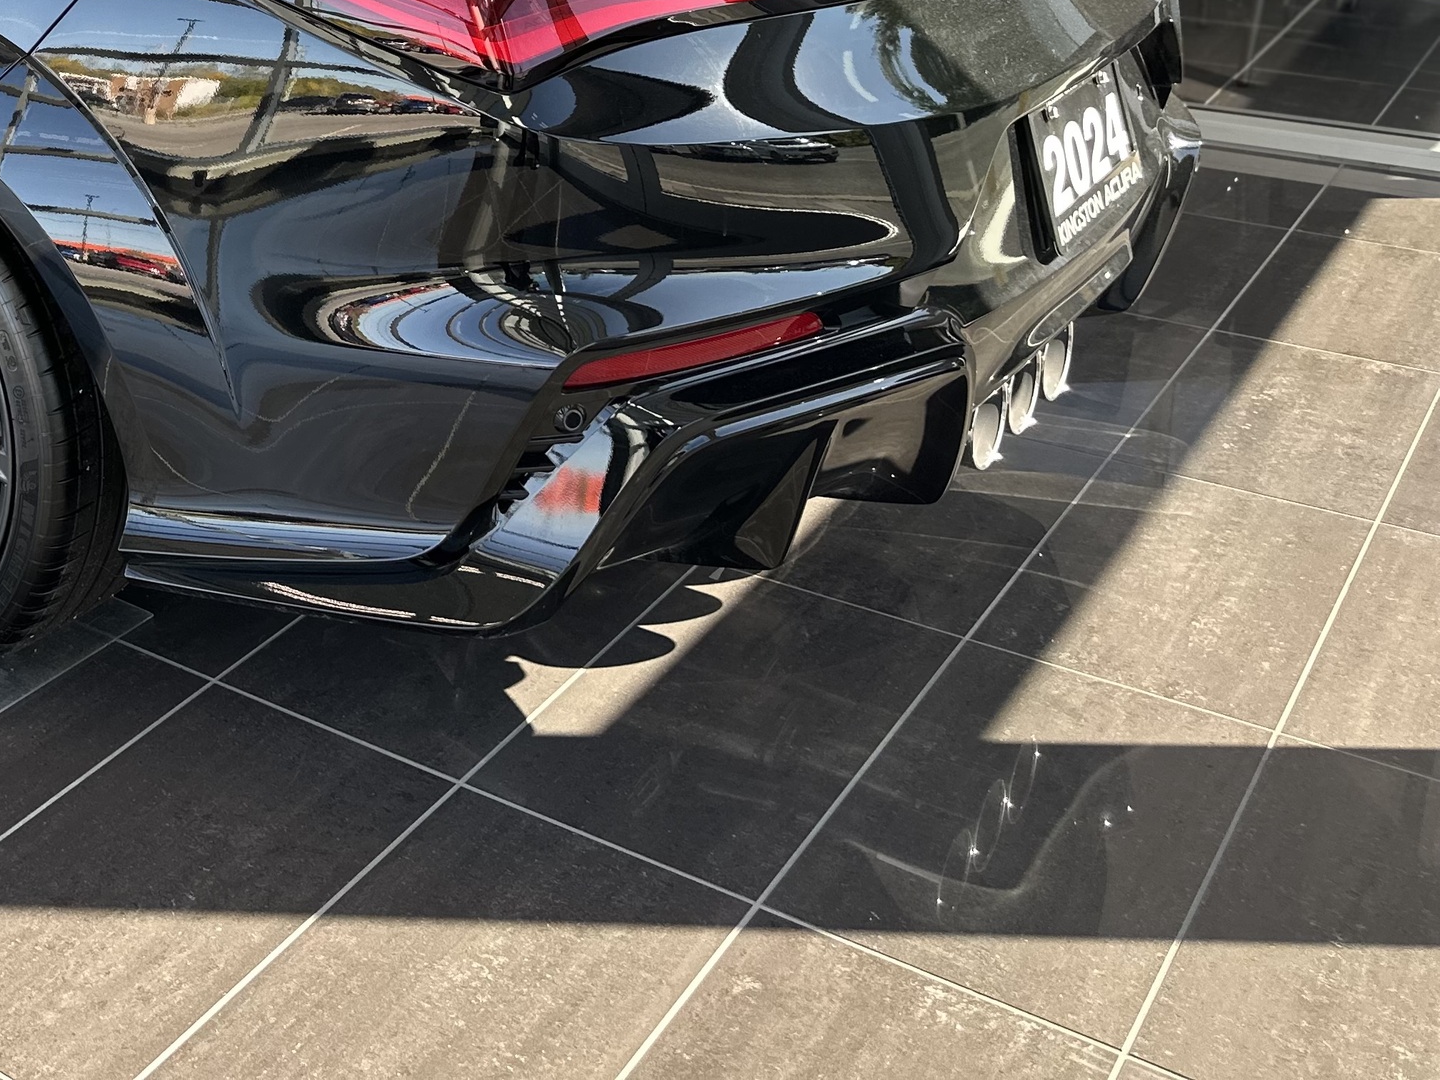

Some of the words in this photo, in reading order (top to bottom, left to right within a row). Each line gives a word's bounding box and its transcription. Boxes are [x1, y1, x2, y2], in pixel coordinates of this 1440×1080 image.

[1043, 91, 1130, 217] 2024
[1057, 193, 1105, 246] KINGSTON
[1104, 163, 1143, 206] ACURA
